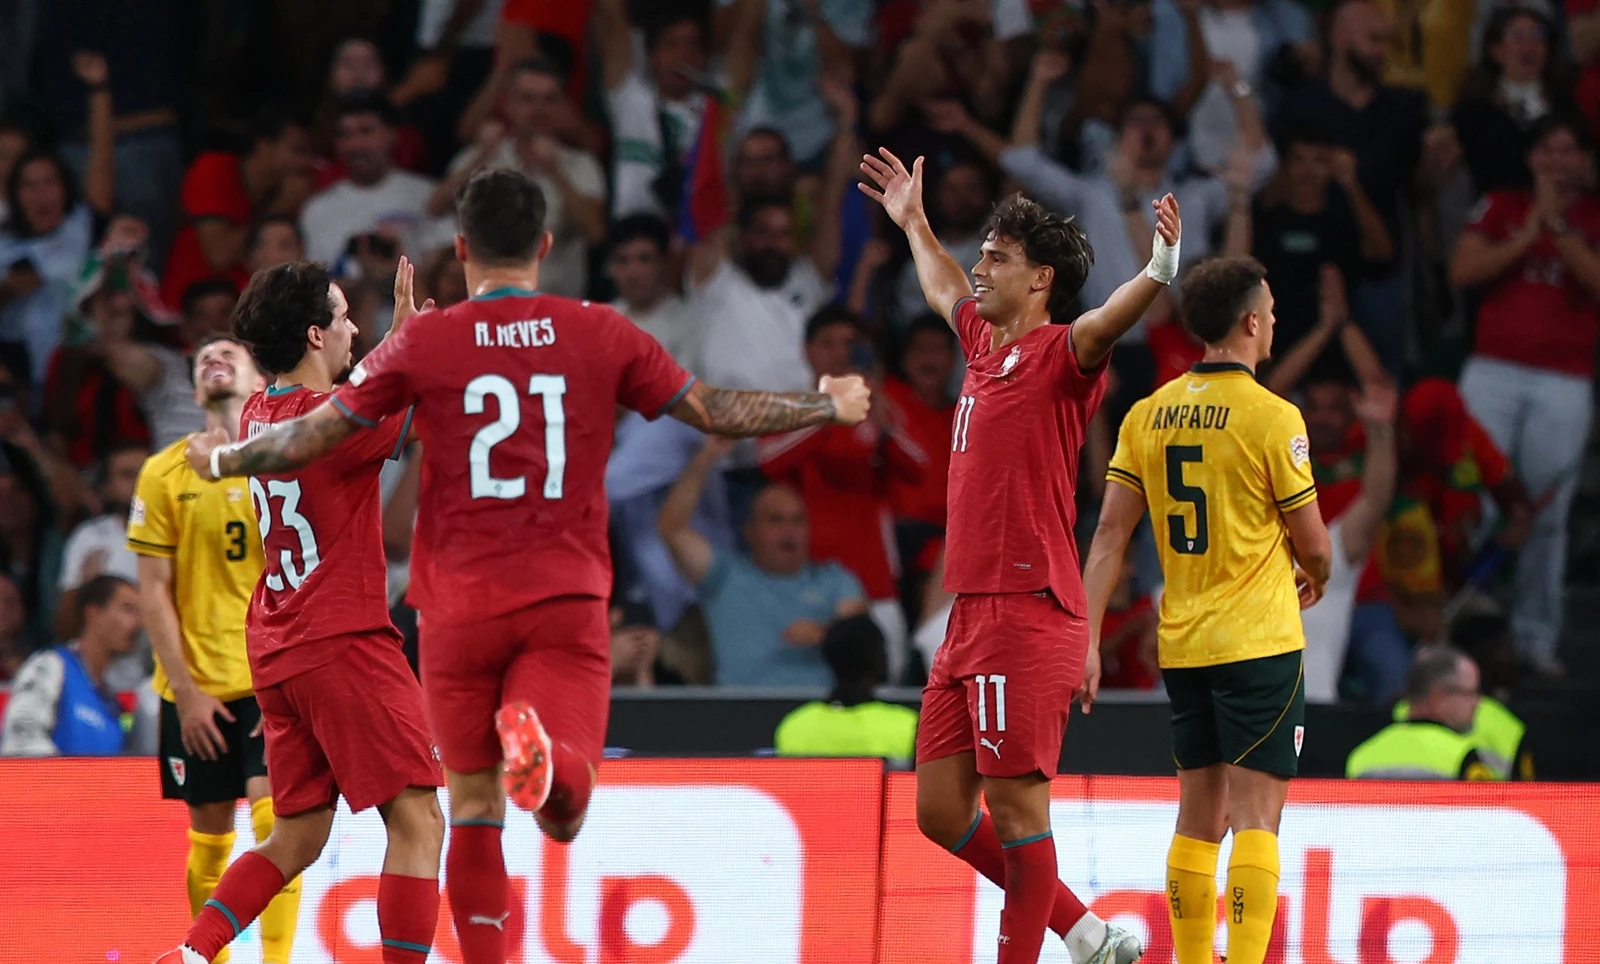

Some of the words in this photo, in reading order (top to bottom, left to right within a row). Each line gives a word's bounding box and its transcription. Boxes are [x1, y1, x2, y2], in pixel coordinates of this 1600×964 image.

[475, 322, 495, 347] R.
[496, 317, 556, 348] NEVES
[463, 374, 567, 499] 21
[952, 395, 976, 453] 11
[1152, 404, 1230, 430] AMPADU
[1165, 445, 1209, 555] 5
[225, 521, 247, 561] 3
[249, 475, 321, 592] 23
[975, 674, 1006, 731] 11
[1088, 847, 1459, 964] lp
[1233, 886, 1245, 924] CYMRU
